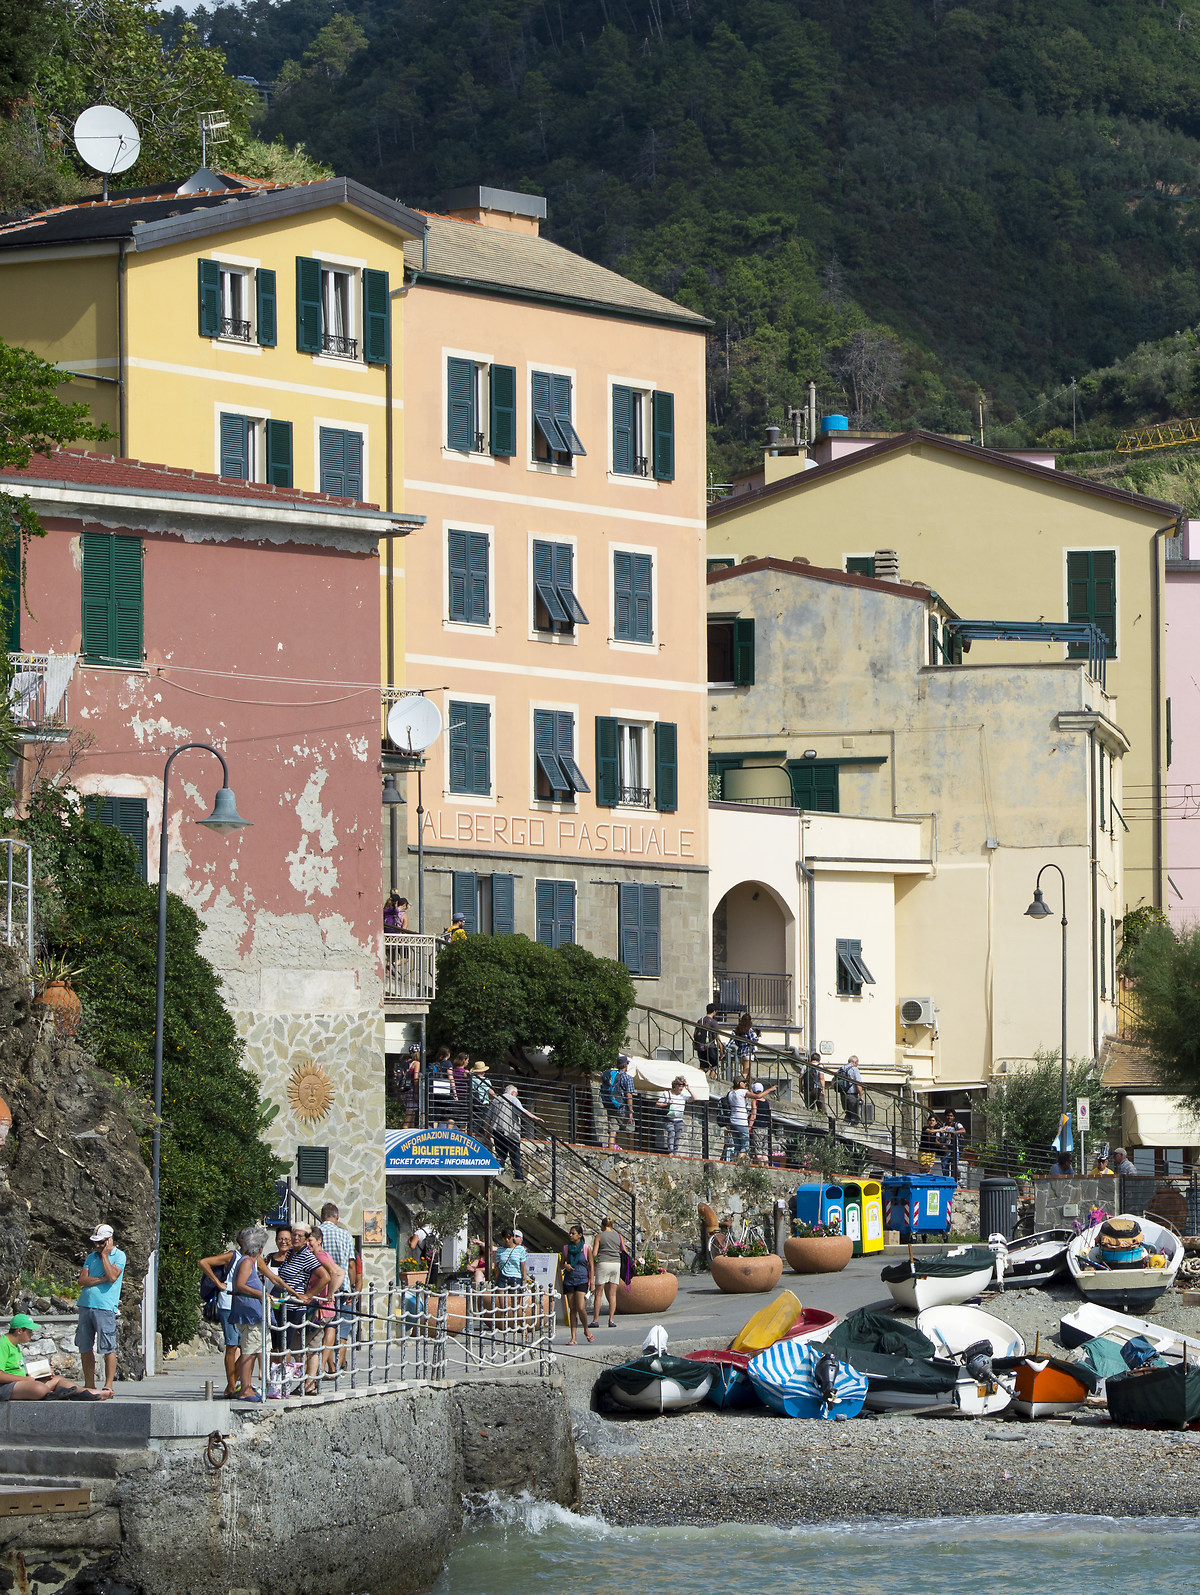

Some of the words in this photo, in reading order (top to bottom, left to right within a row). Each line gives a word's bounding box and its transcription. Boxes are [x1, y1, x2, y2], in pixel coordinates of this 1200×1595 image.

[421, 809, 545, 846] ALBERGO
[557, 820, 695, 857] PASQUALE
[401, 1131, 449, 1152] INFORMAZIONI
[450, 1132, 481, 1154] BATTELLI
[411, 1146, 469, 1156] BIGLIETTERIA
